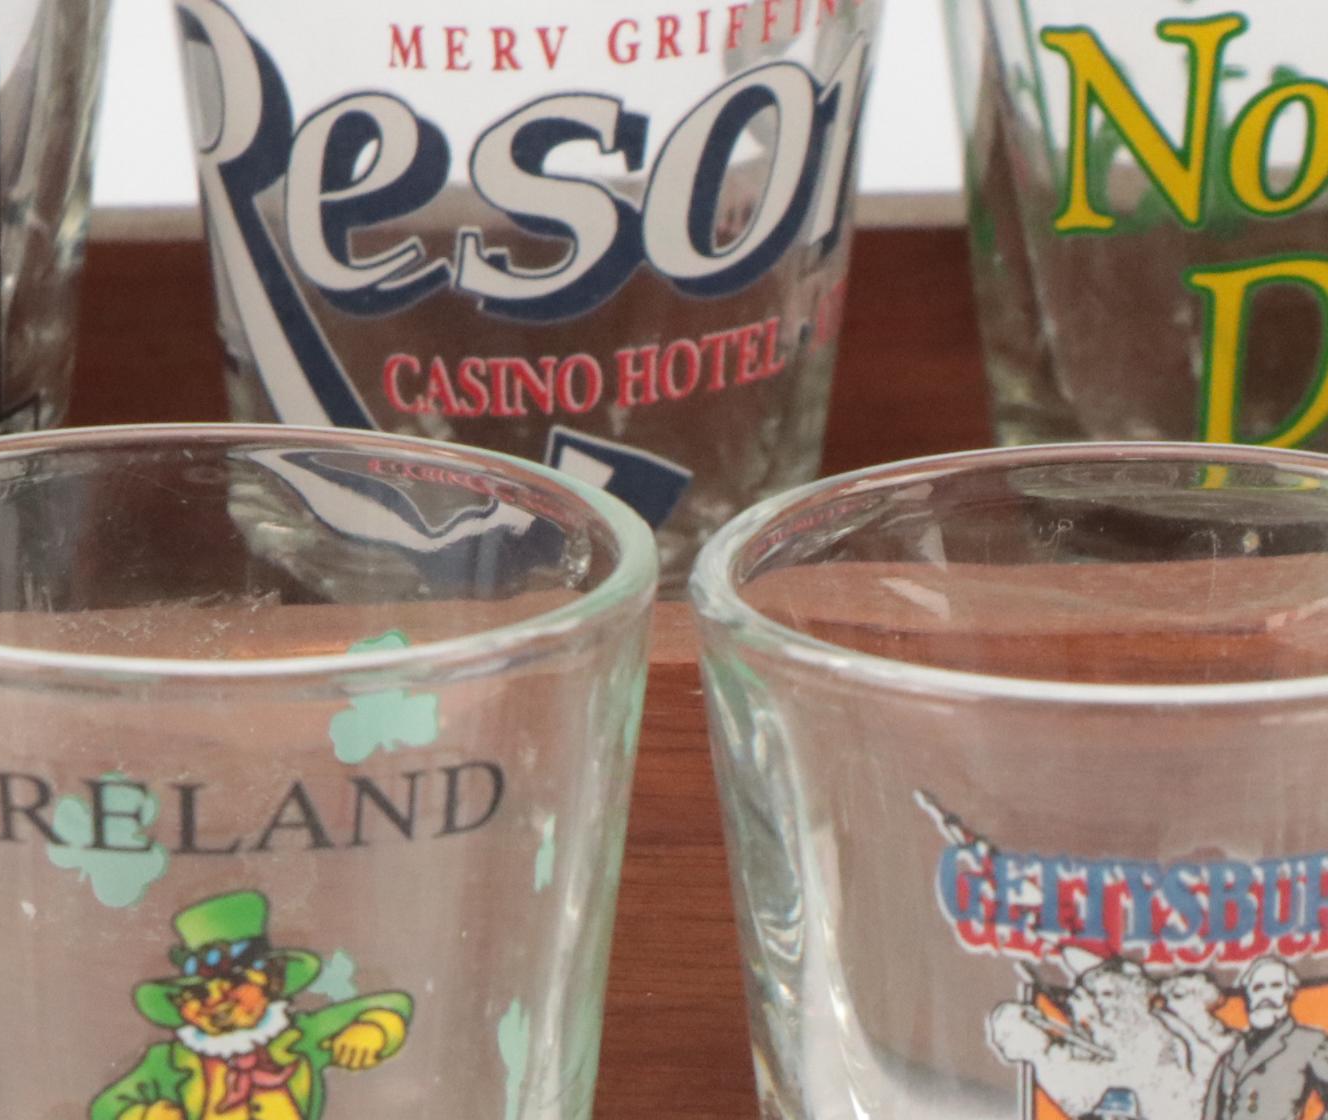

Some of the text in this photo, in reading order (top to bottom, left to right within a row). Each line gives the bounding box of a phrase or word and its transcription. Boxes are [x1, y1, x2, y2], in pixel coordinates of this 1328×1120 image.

[388, 24, 569, 71] MERV
[382, 352, 603, 417] CASINO
[614, 316, 787, 410] HOTEL
